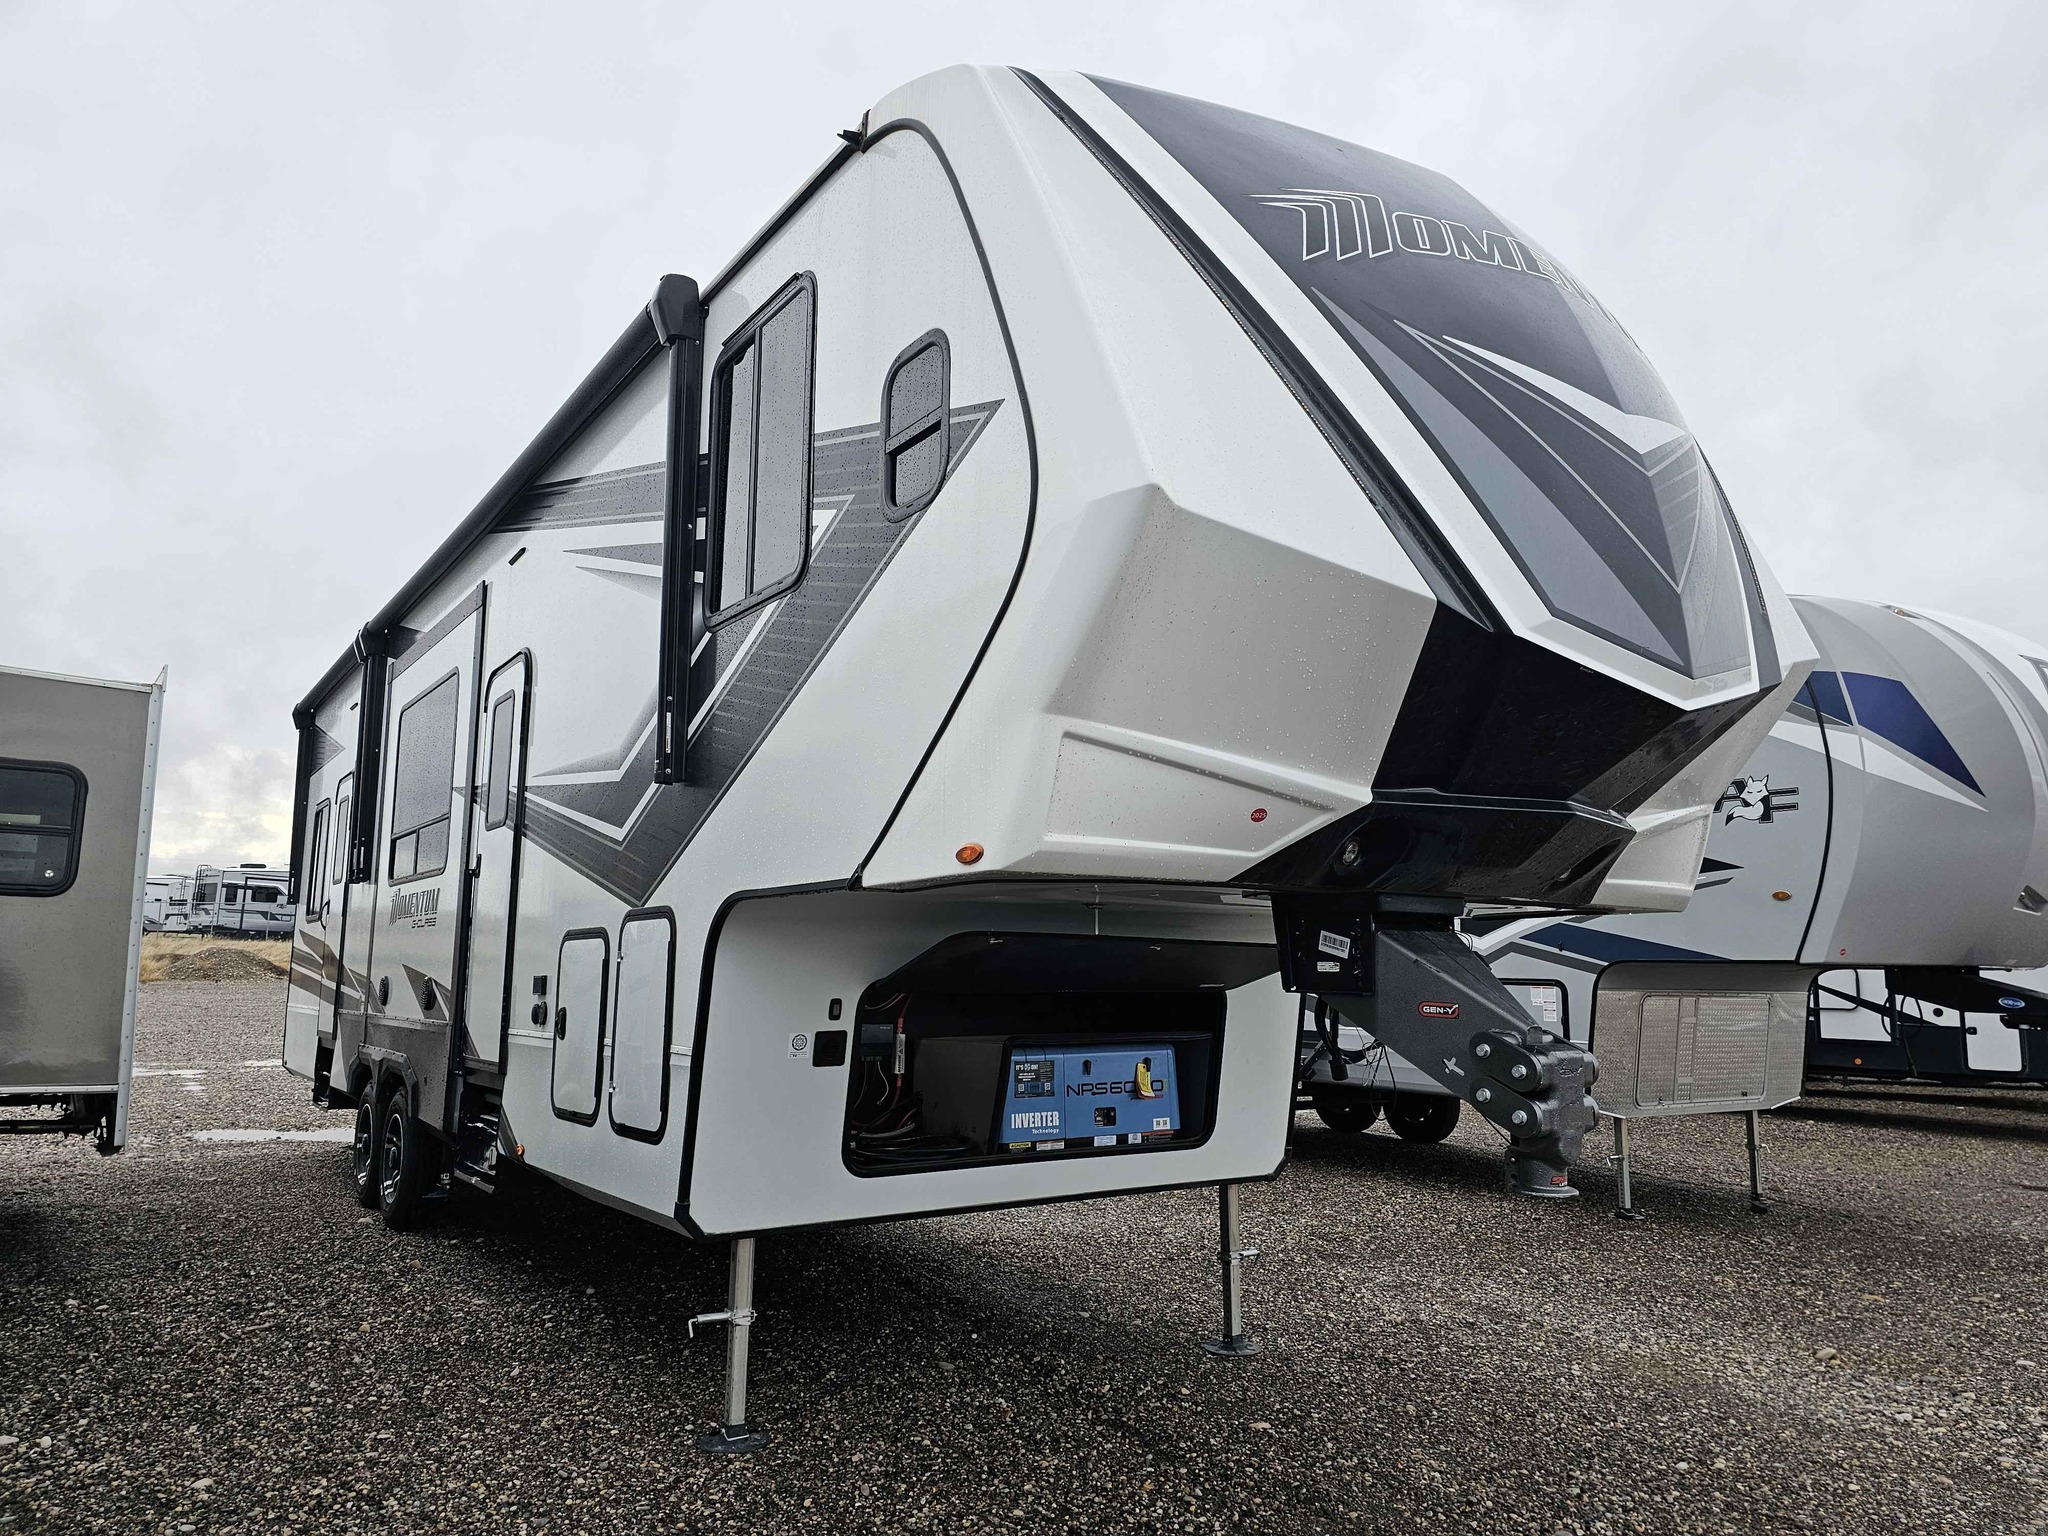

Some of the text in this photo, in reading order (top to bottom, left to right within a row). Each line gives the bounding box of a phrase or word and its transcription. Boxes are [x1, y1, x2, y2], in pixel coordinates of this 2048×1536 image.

[389, 888, 440, 926] MOMENTUM
[1422, 1004, 1459, 1015] GEN-Y
[1066, 1079, 1164, 1098] NPS600
[1011, 1111, 1060, 1129] INVERTER
